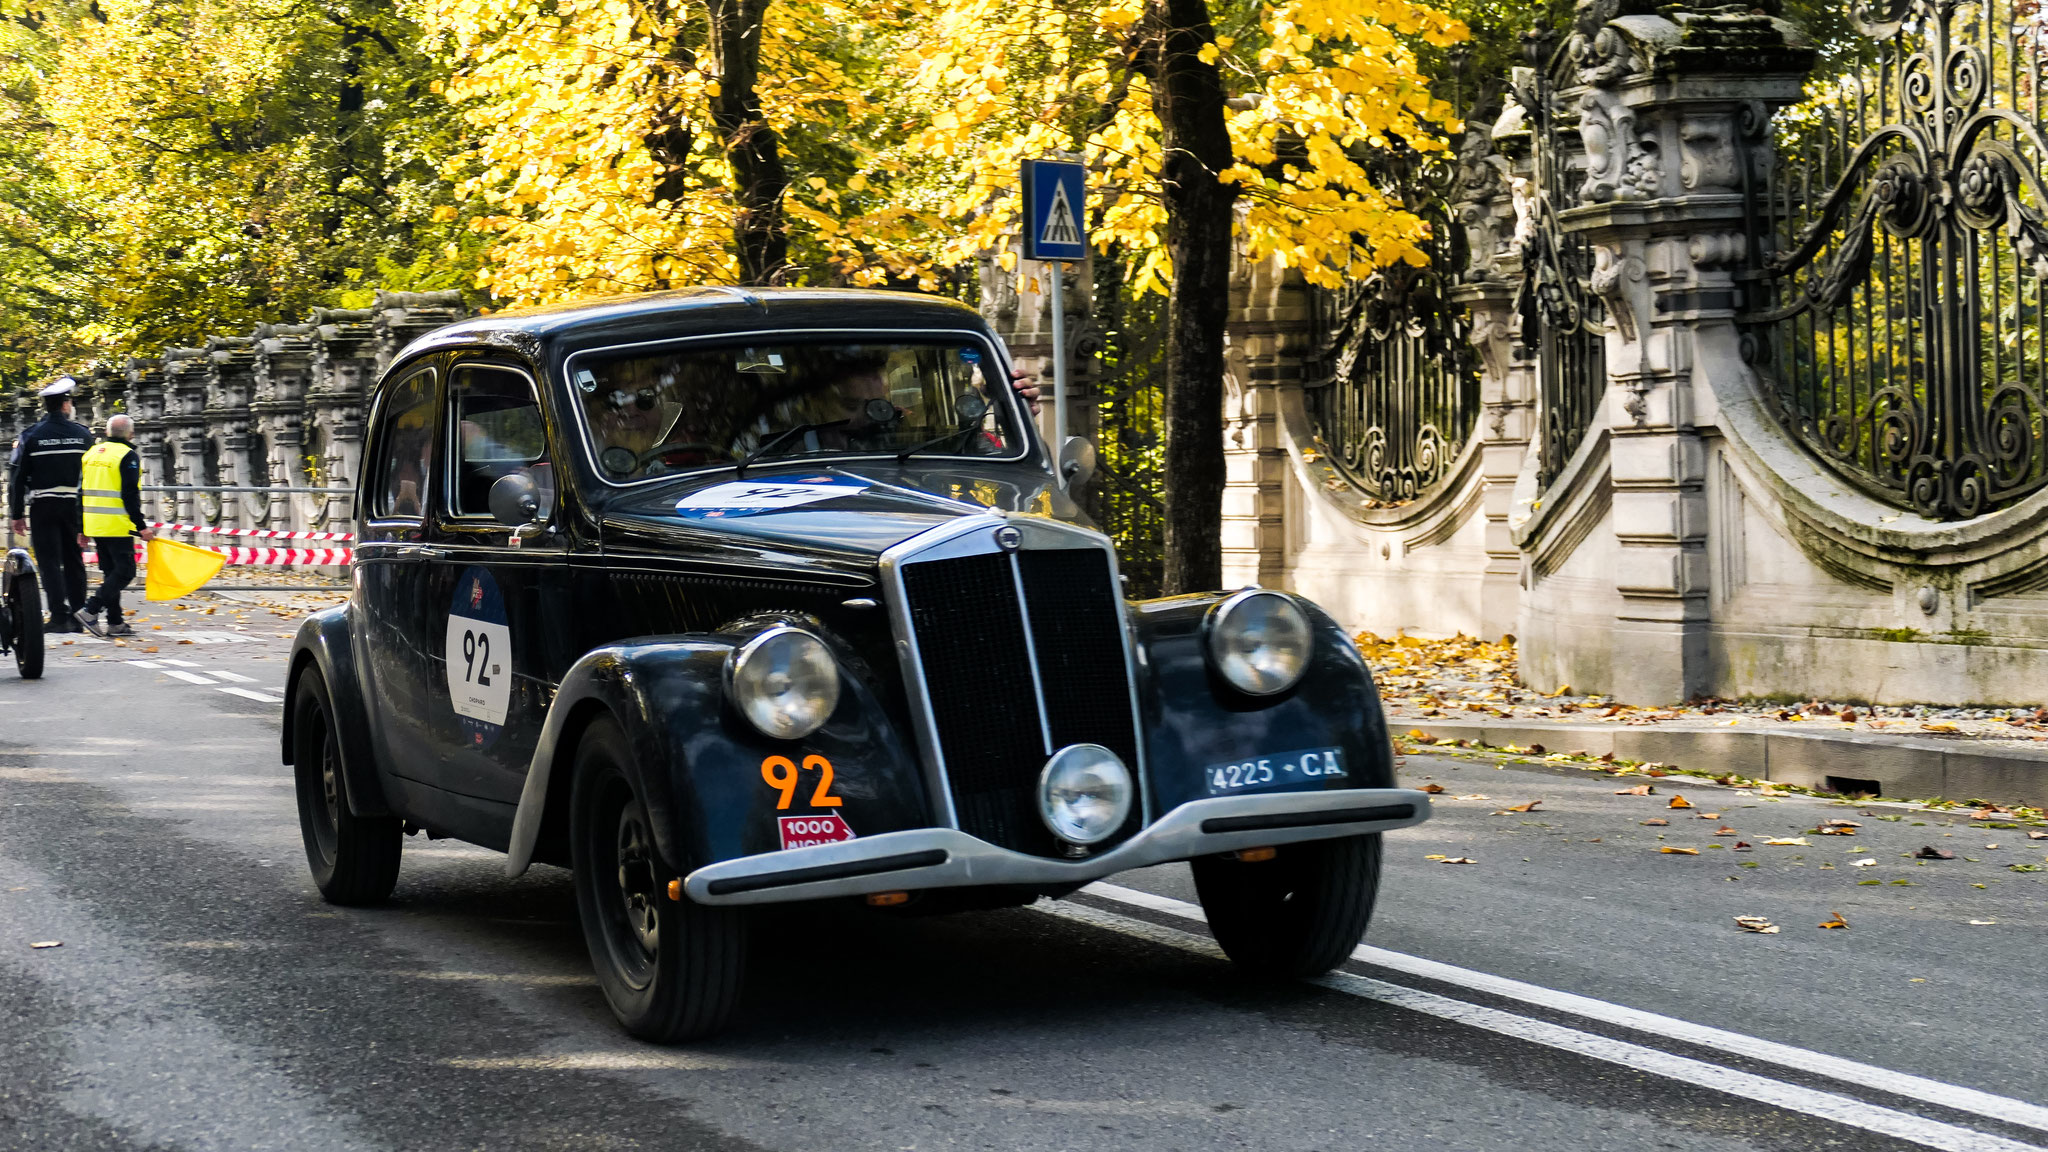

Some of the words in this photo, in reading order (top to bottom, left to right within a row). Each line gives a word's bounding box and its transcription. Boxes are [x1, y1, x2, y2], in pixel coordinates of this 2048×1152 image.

[733, 488, 815, 498] 92
[464, 630, 490, 686] 92
[761, 755, 843, 809] 92
[1213, 760, 1273, 789] 4225
[1300, 751, 1342, 776] CA
[787, 820, 834, 834] 1000
